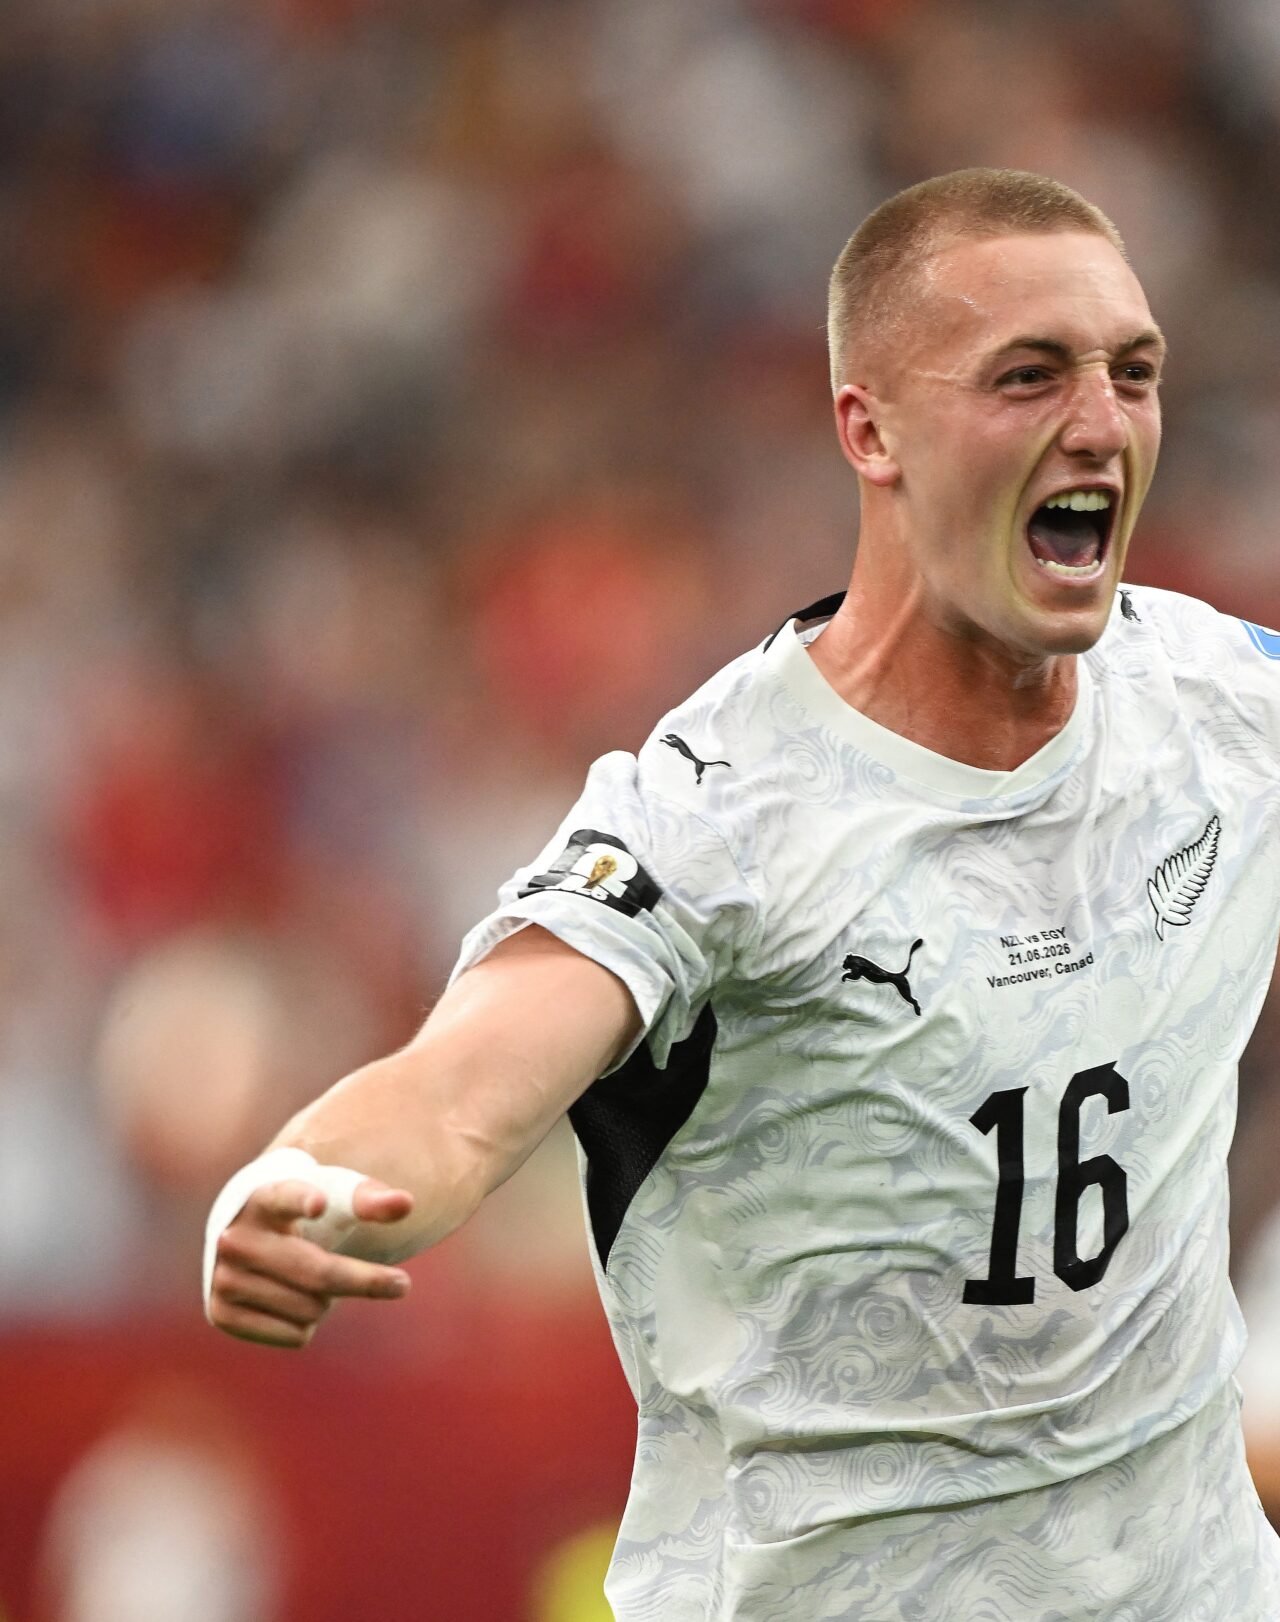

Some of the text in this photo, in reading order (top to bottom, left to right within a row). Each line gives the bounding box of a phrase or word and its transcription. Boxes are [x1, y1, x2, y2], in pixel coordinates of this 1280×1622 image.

[1000, 927, 1066, 948] NZL vs EGY
[1008, 943, 1071, 965] 21.06.2026
[987, 952, 1094, 988] Vancouver, Canad
[962, 1060, 1130, 1305] 16
